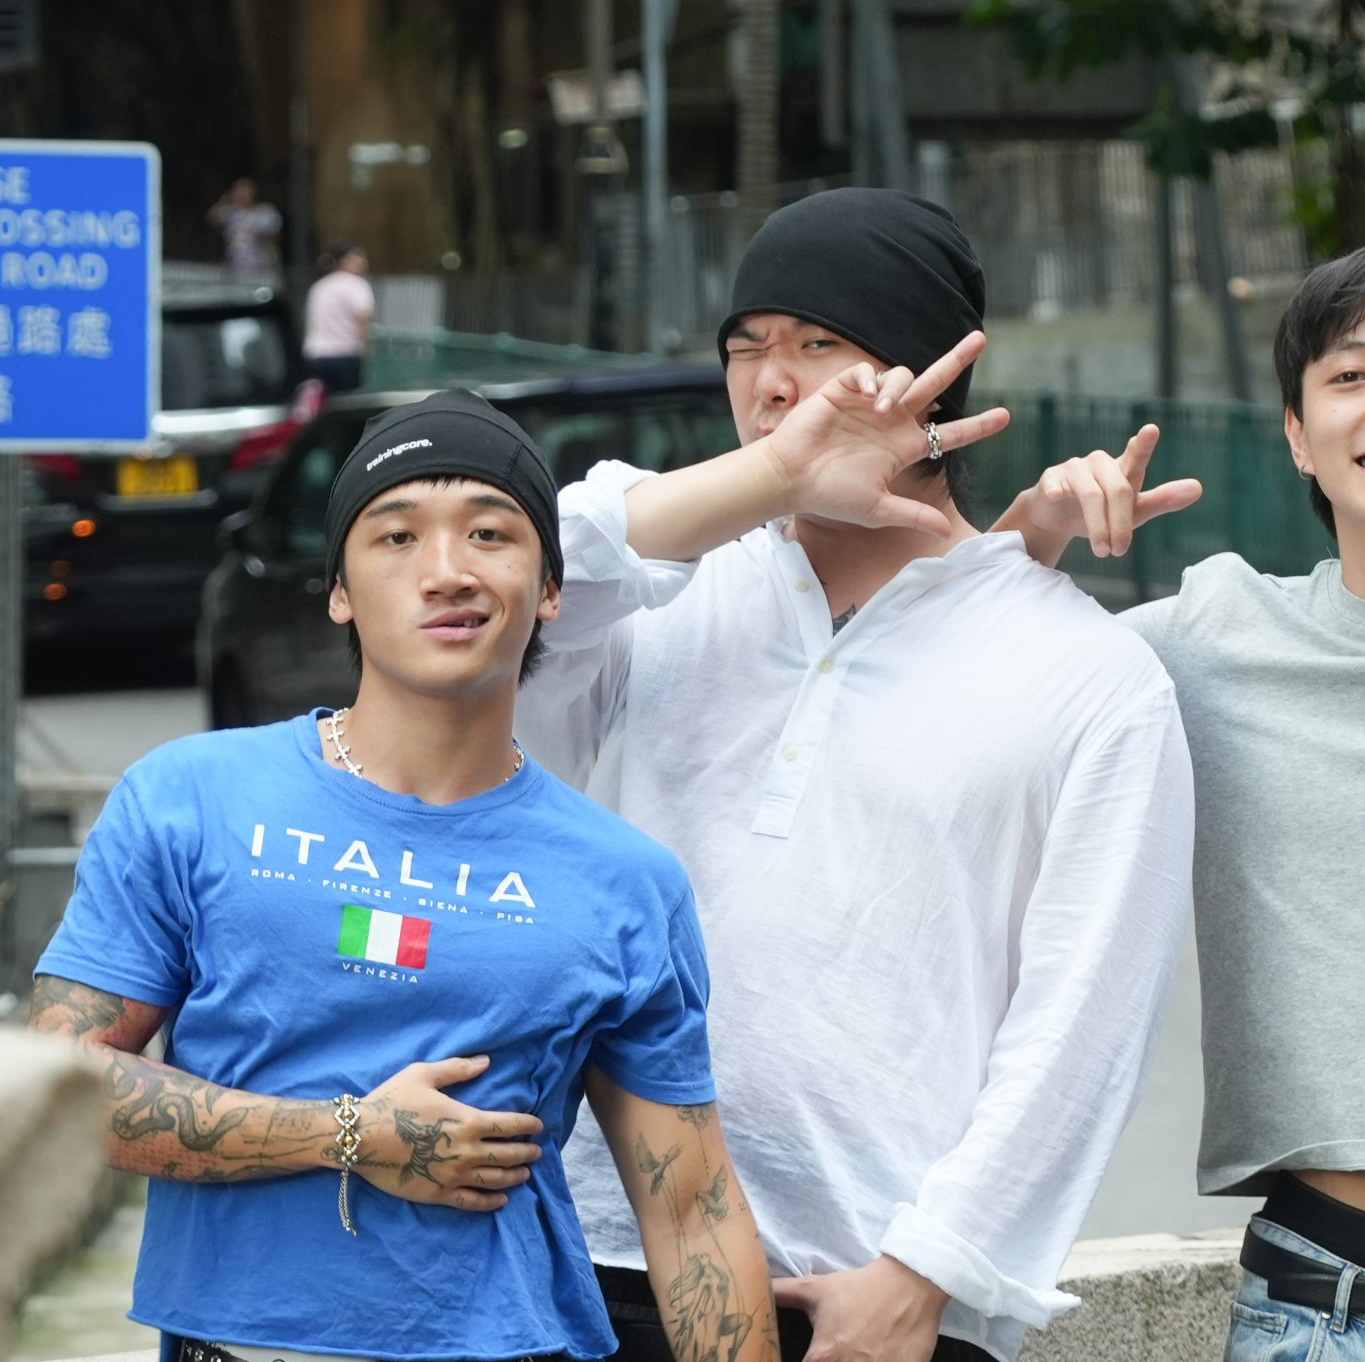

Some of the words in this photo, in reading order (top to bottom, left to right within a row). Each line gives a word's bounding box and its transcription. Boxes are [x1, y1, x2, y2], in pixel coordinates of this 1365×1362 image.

[0, 252, 109, 290] ROAD
[251, 823, 536, 908] ITALIA
[251, 868, 296, 881] ROMA
[322, 879, 392, 899] FIRENZE
[341, 962, 419, 984] VENEZIA
